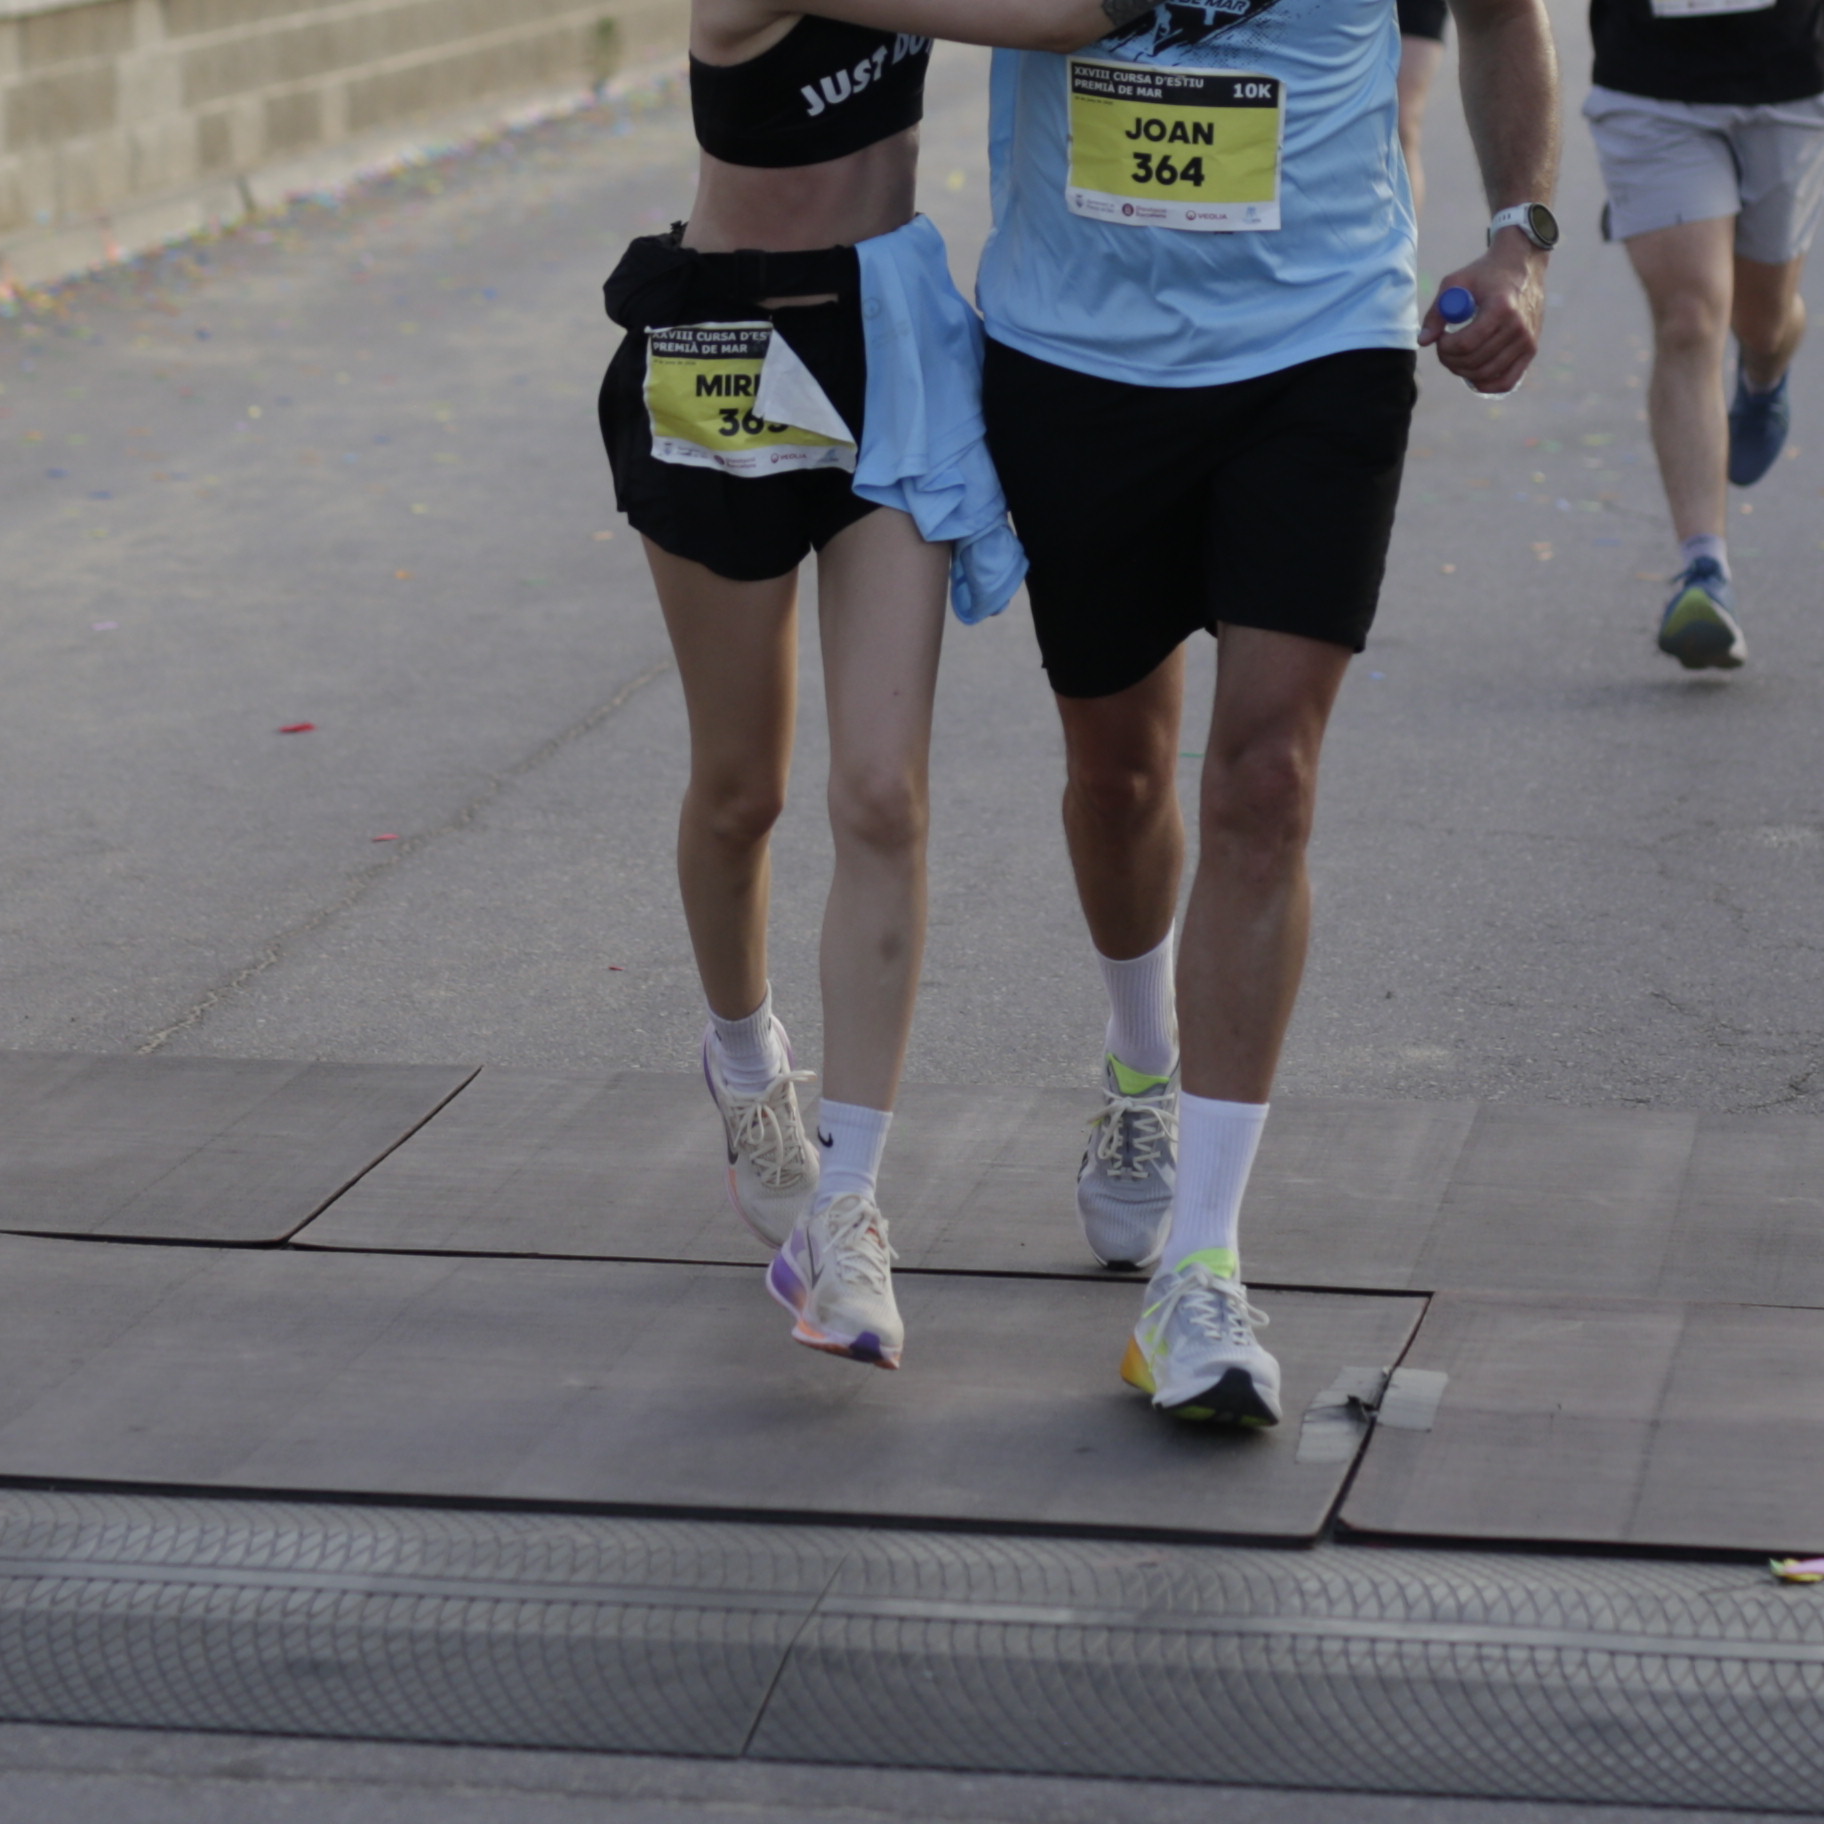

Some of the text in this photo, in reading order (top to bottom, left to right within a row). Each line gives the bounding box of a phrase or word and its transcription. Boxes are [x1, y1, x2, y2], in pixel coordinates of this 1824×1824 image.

[800, 45, 888, 117] JUST
[1074, 66, 1204, 88] XXVIII CURSA D'ESTIU
[1074, 78, 1163, 98] PREMIÀ DE MAR
[1233, 83, 1272, 99] 10K
[1125, 117, 1215, 146] JOAN
[1131, 152, 1206, 187] 364
[1197, 212, 1228, 220] VEOLIA
[696, 331, 737, 342] CURSA
[740, 331, 770, 341] D'ES
[653, 340, 748, 354] PREMIÀ DE MAR
